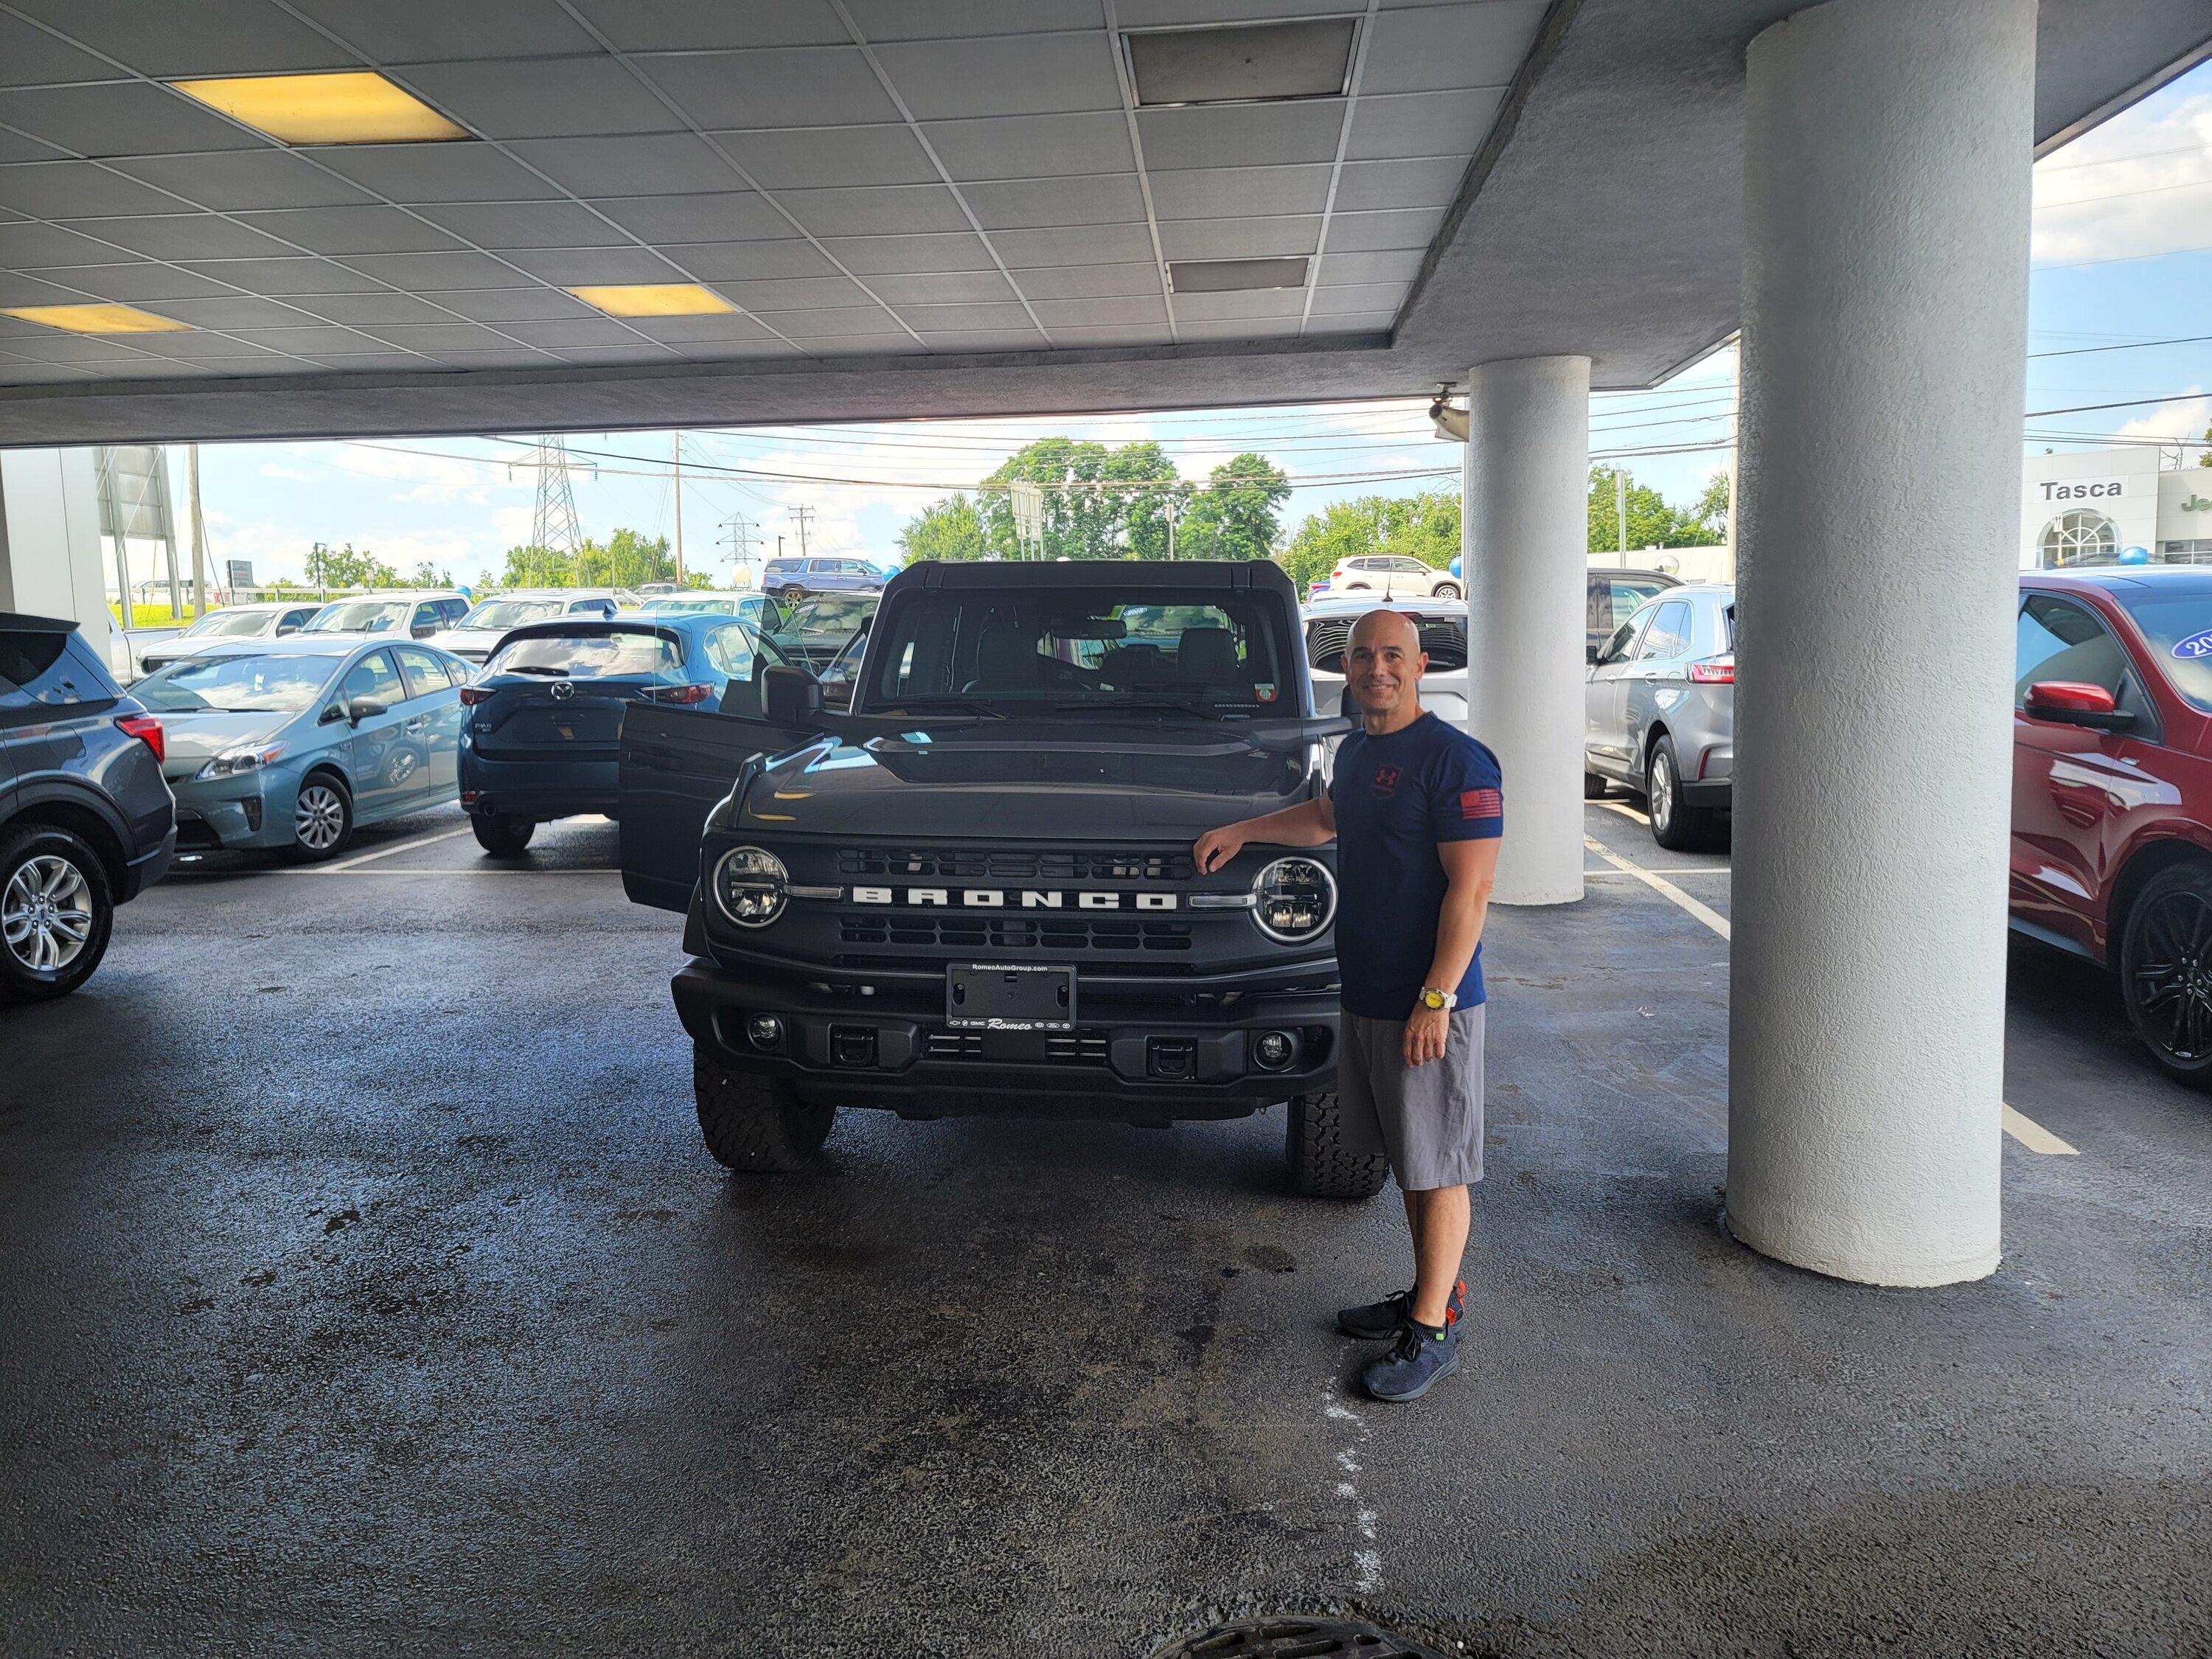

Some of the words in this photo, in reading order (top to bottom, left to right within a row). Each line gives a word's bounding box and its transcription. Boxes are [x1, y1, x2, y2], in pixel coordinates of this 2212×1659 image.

[2039, 481, 2123, 501] Tasca
[2180, 494, 2212, 512] Je
[2185, 633, 2212, 655] 20
[852, 886, 1178, 910] BRONCO
[972, 964, 1048, 973] RomeoAutoGroup.com
[987, 1018, 1032, 1030] Romeo
